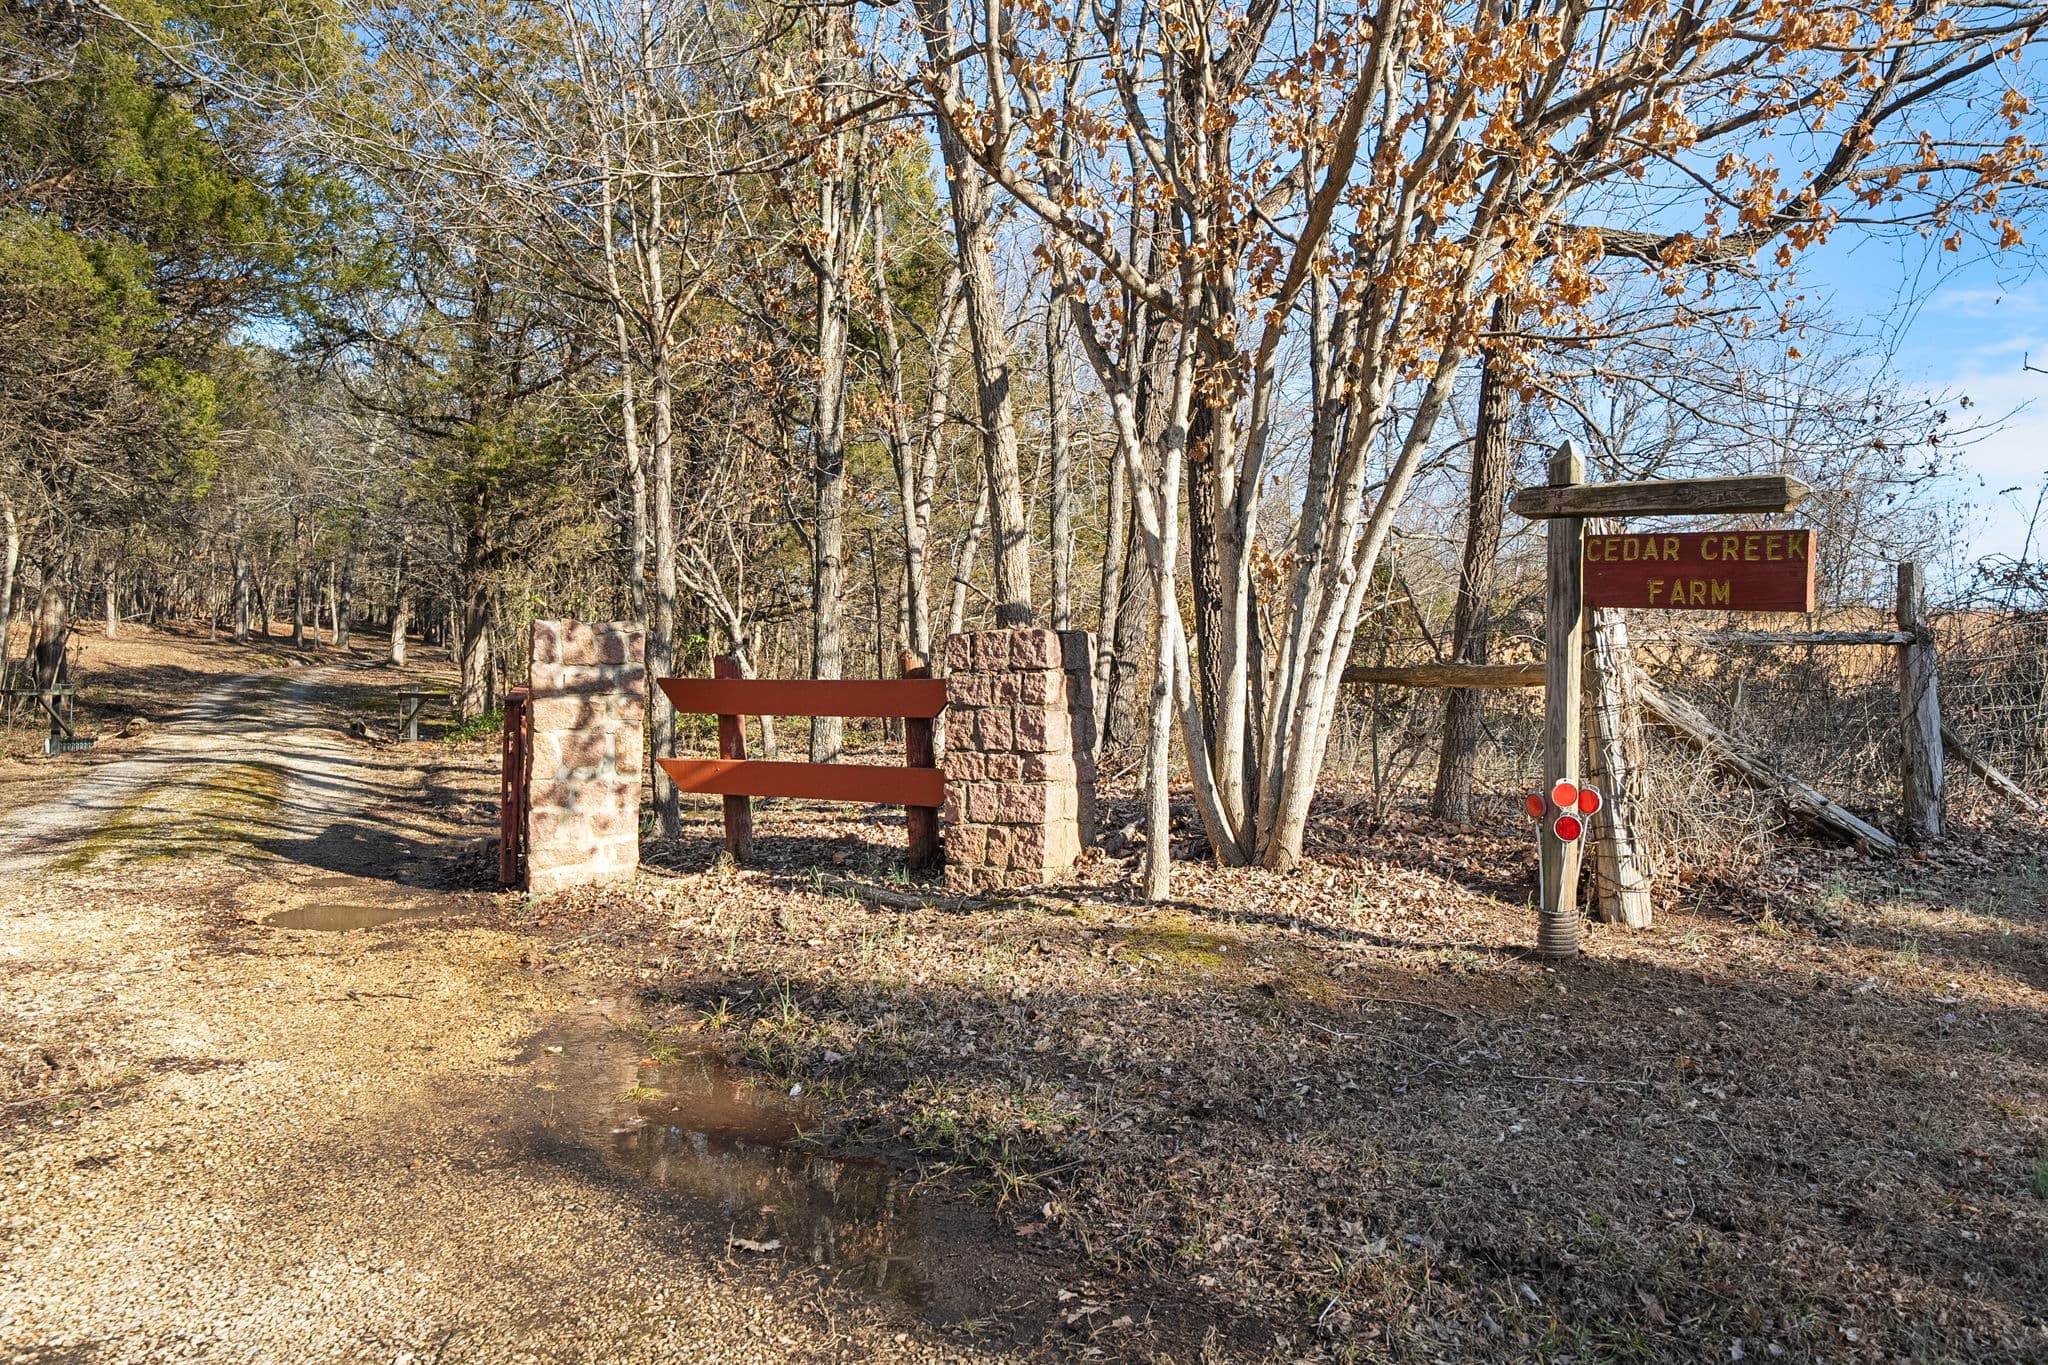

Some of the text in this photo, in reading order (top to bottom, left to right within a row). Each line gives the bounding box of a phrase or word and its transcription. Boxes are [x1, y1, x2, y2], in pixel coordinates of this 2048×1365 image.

[1586, 533, 1806, 562] CEDAR CREEK
[1648, 578, 1731, 606] FARM
